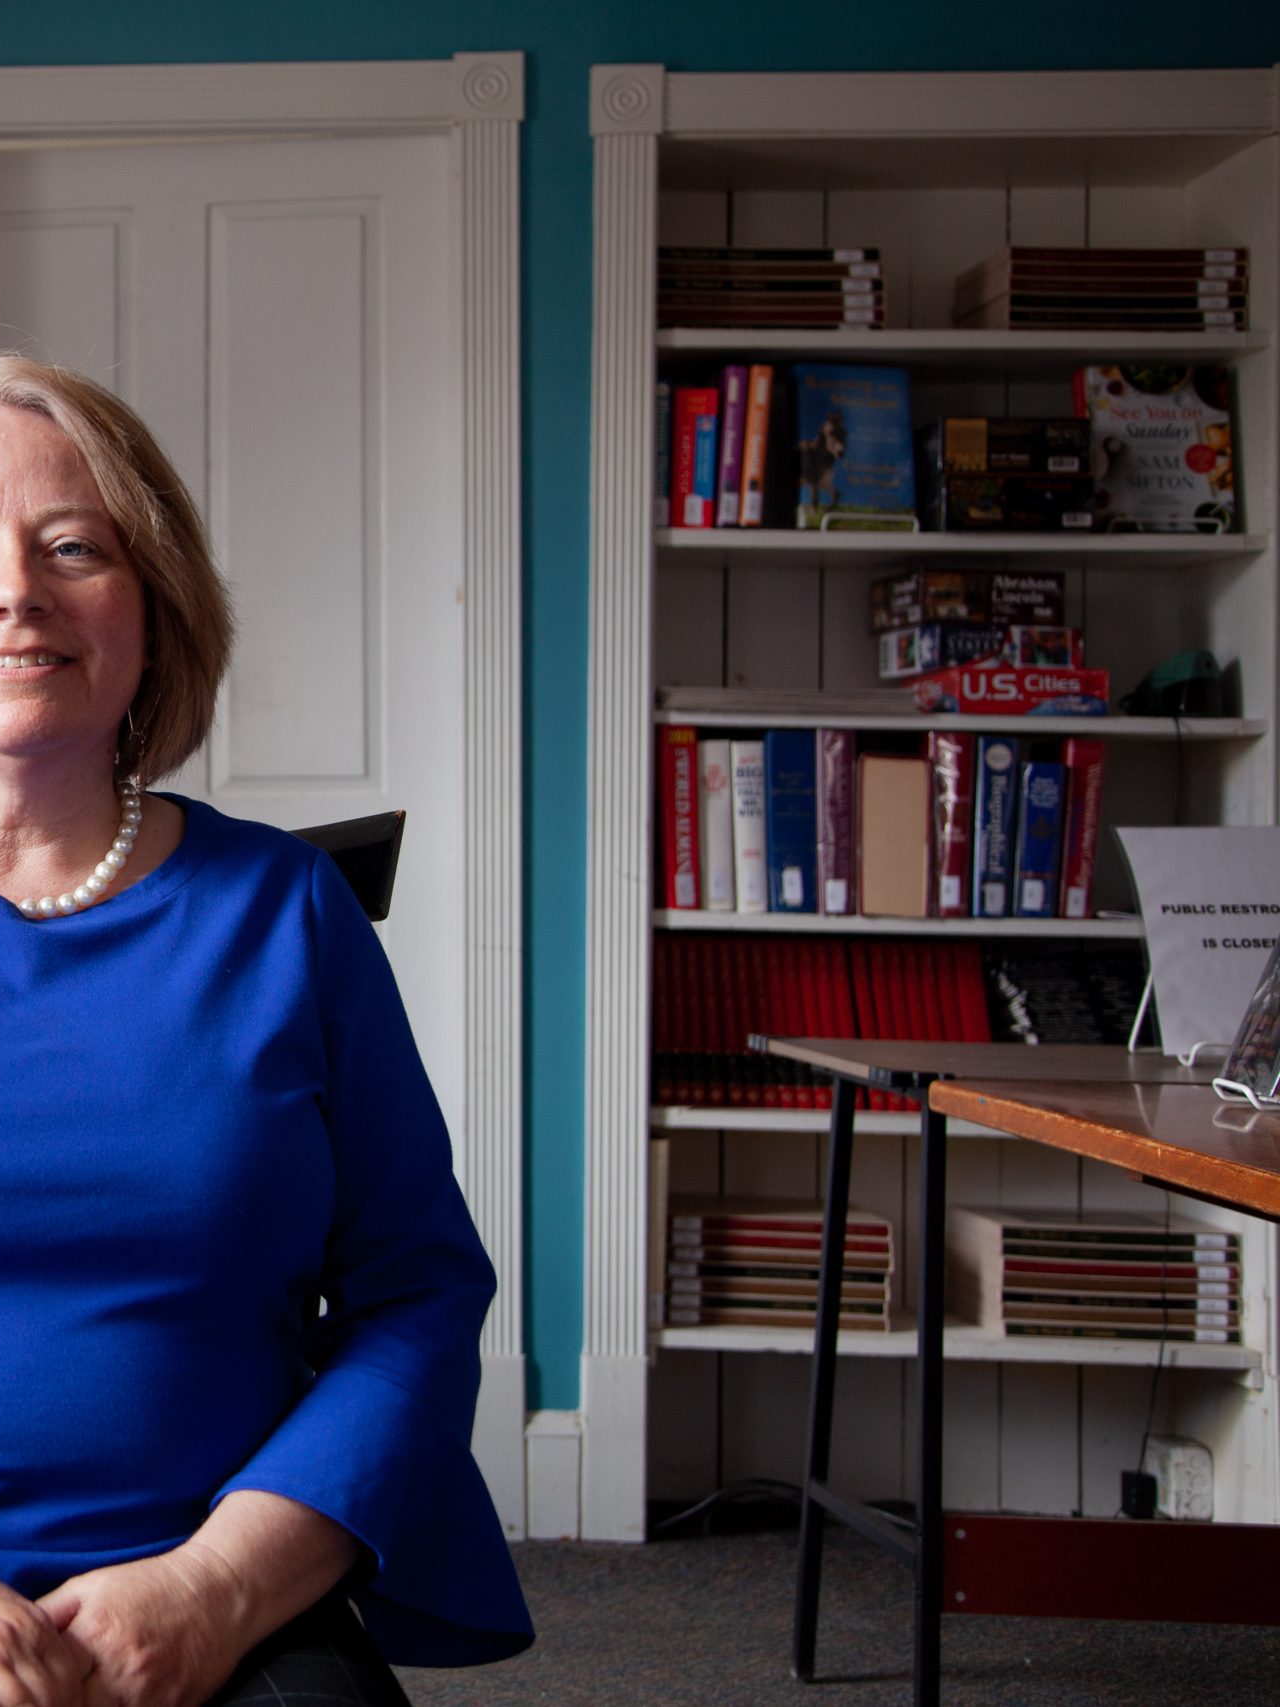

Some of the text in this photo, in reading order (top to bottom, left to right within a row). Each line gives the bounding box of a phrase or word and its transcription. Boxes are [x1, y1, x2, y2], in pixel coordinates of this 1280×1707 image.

[1145, 404, 1177, 419] You
[1125, 420, 1193, 441] Sunday
[1138, 453, 1181, 470] SAM
[961, 673, 1024, 702] U.S.
[1024, 673, 1081, 693] Cities
[1161, 904, 1280, 914] PUBLIC RESTRO
[1202, 938, 1217, 949] IS
